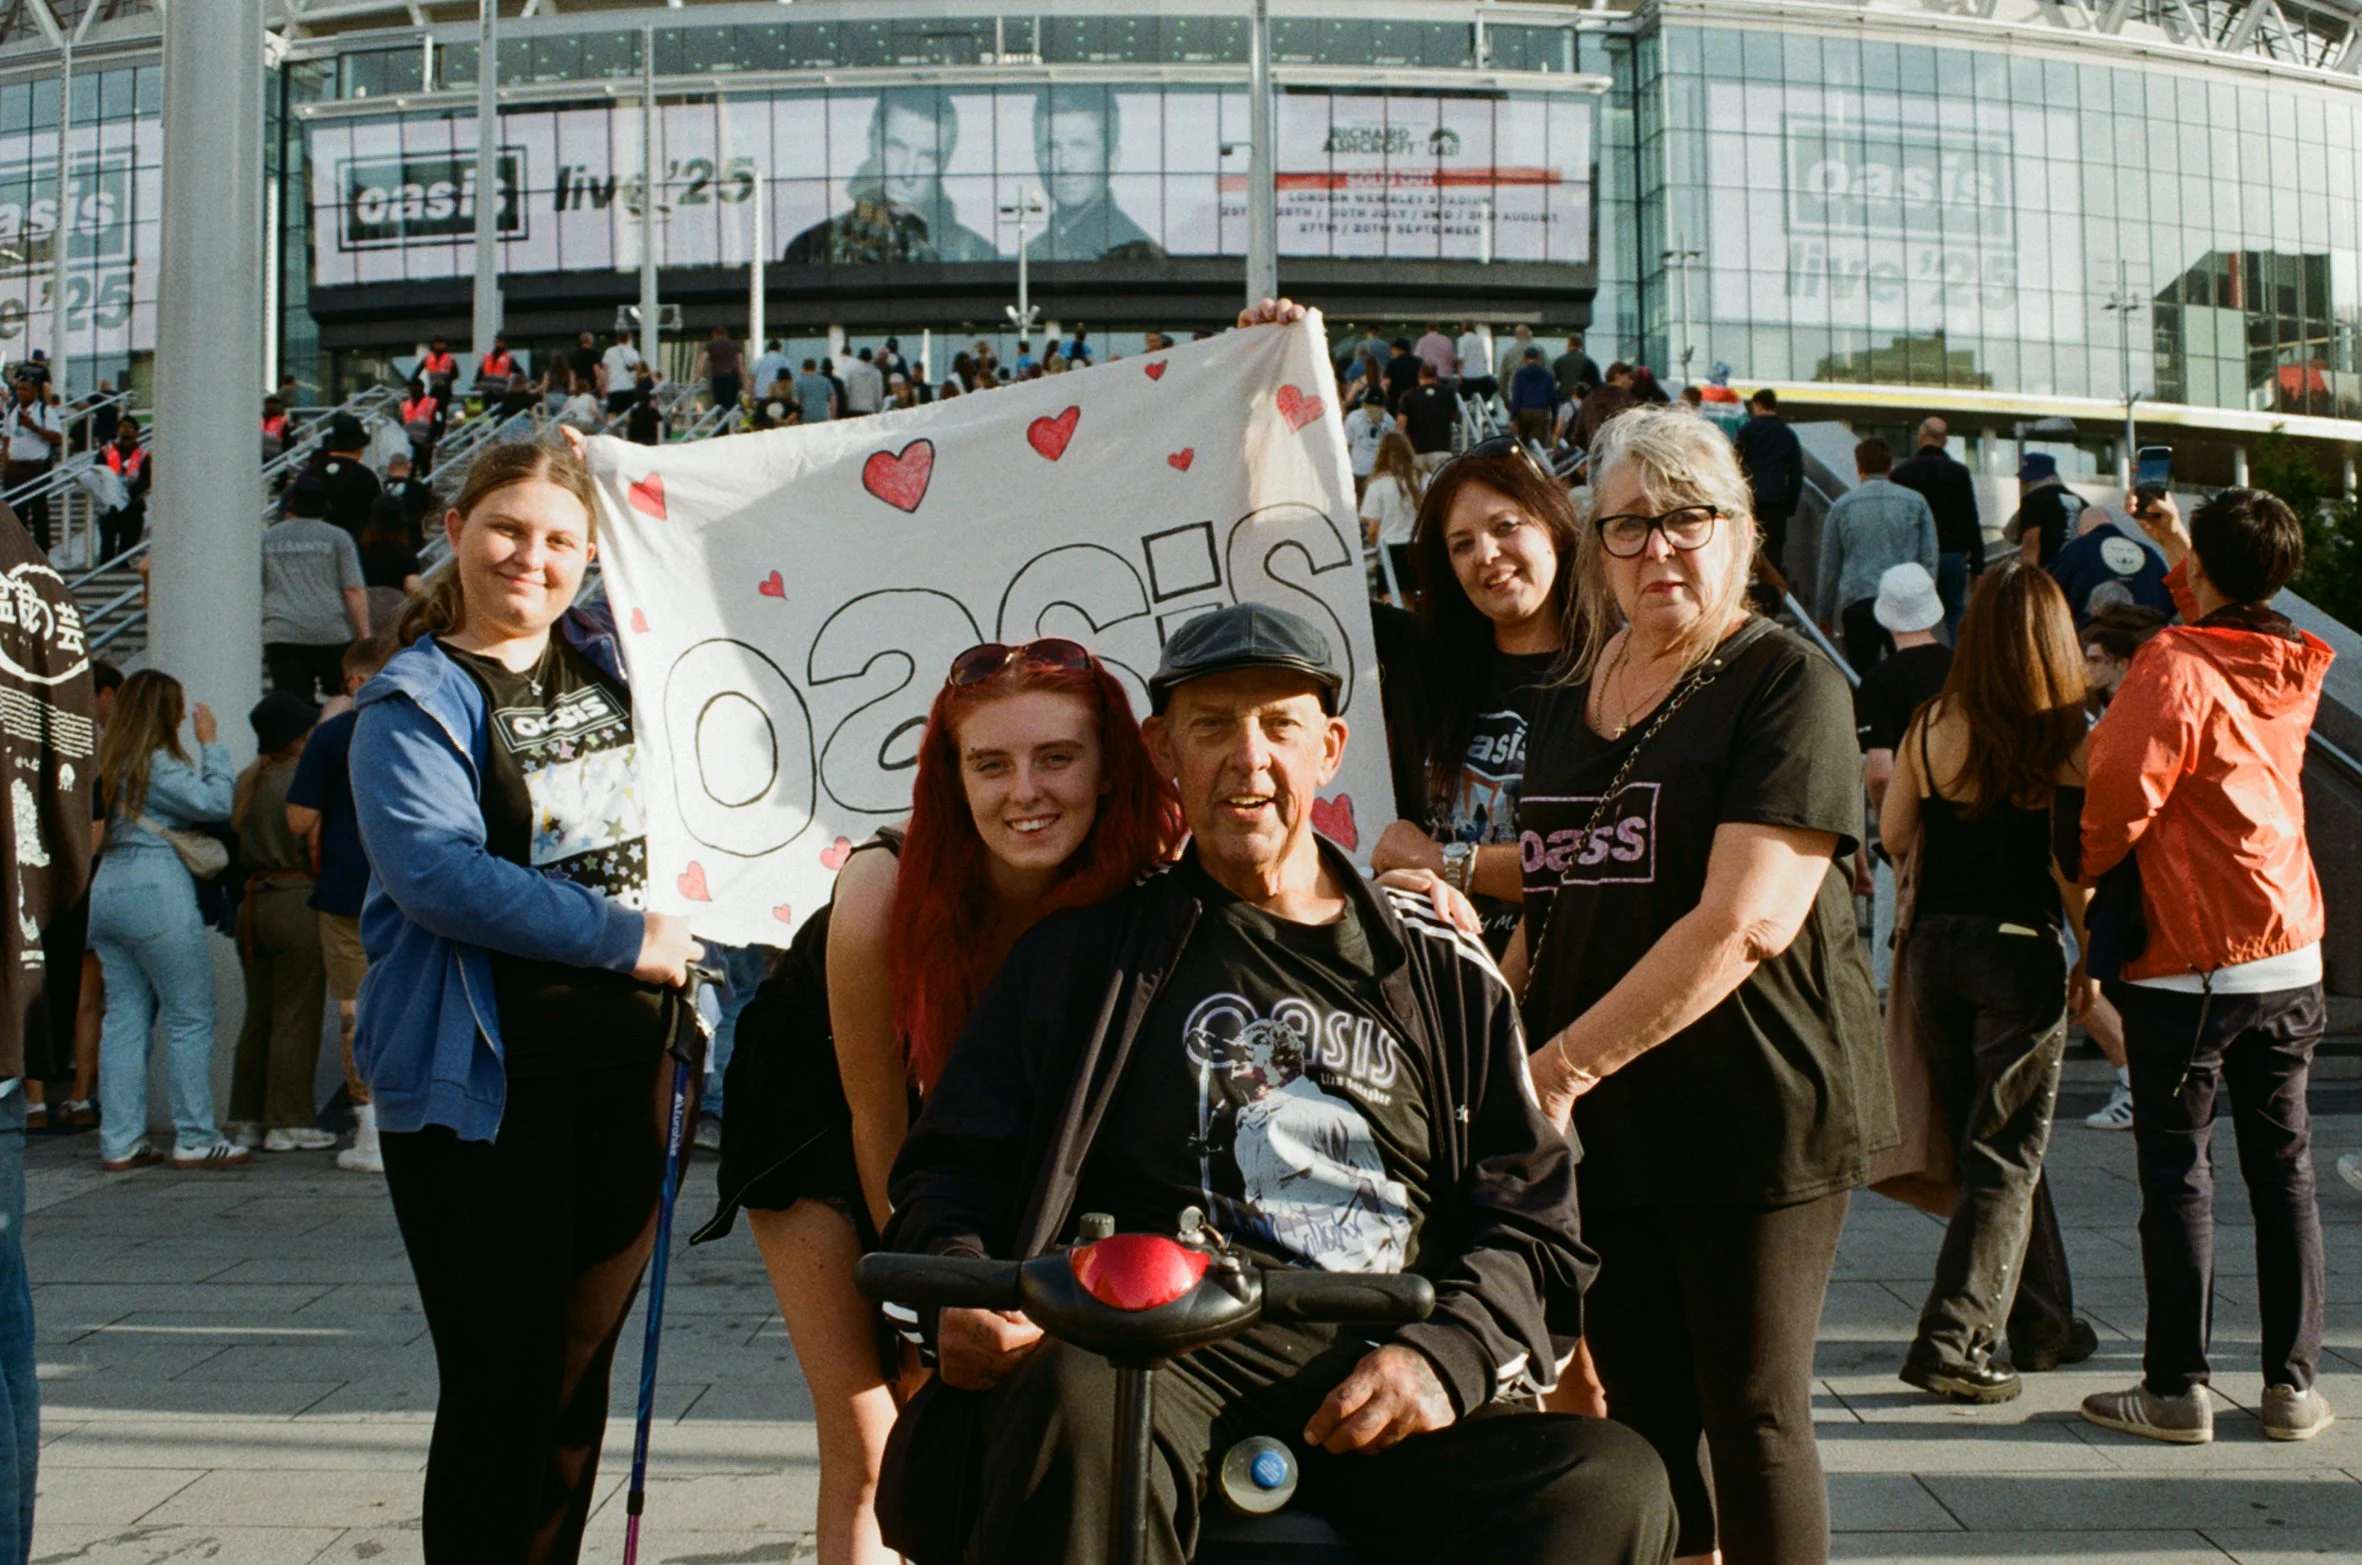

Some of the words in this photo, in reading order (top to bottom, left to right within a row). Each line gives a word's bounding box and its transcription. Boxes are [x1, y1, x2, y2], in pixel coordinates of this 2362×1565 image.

[0, 180, 116, 245] asis
[1808, 155, 1993, 213] oasis
[1785, 241, 1906, 301] live
[1467, 726, 1526, 764] asi
[1519, 816, 1647, 873] oass
